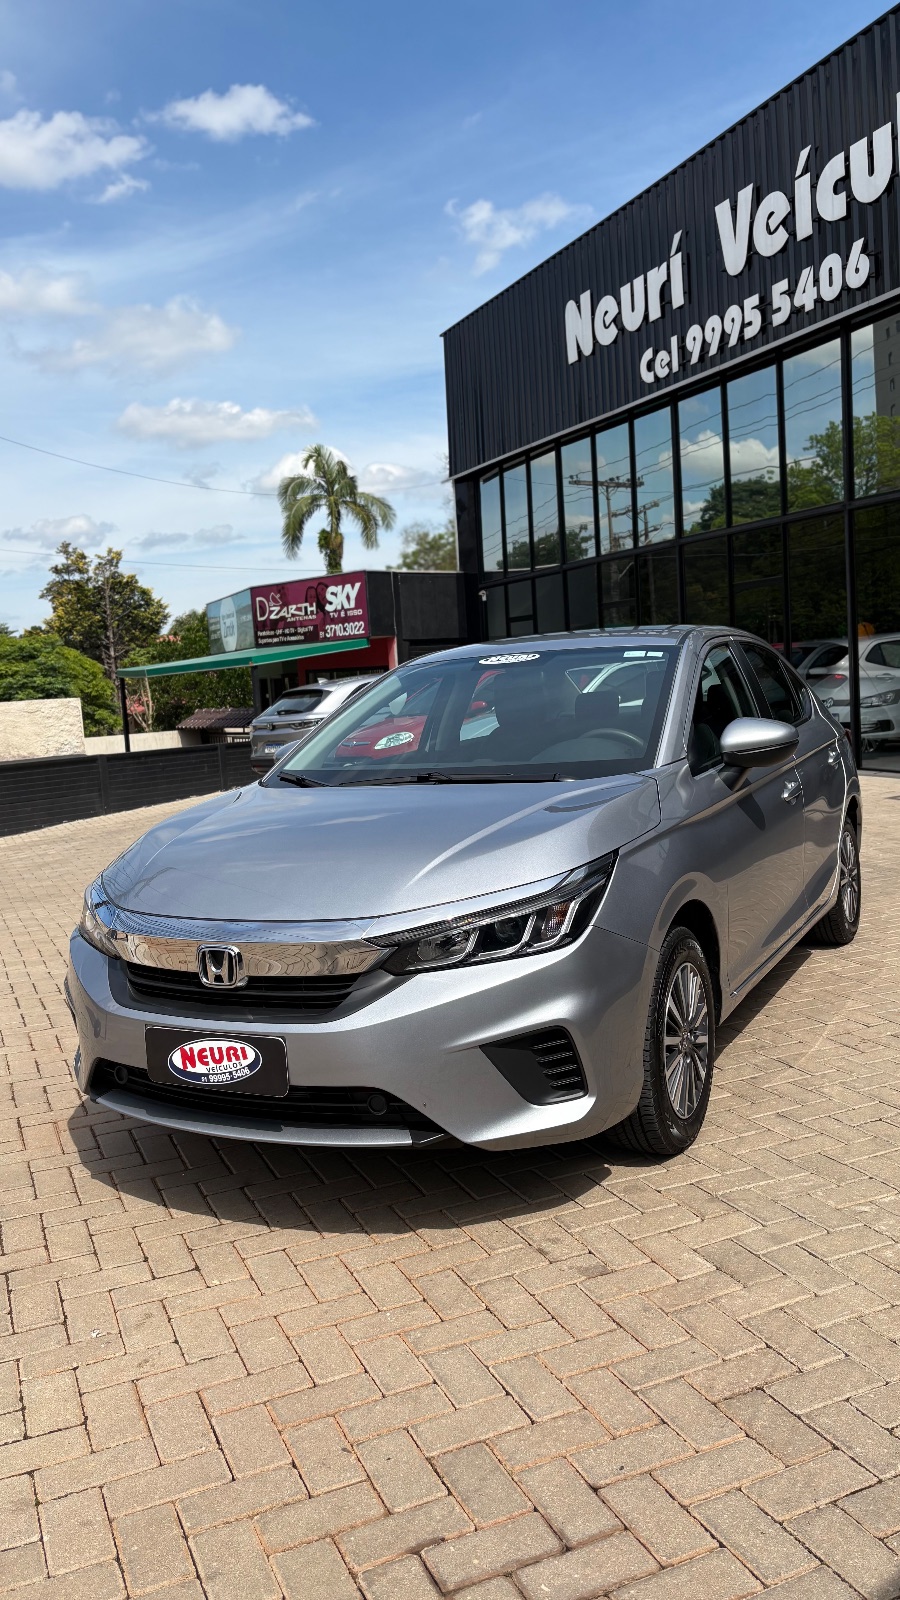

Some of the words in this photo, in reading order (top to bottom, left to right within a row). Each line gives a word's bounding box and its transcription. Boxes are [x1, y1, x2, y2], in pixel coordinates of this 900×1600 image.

[714, 91, 900, 276] Veícu
[640, 335, 679, 383] Cel
[685, 293, 762, 365] 9995
[771, 237, 870, 327] 5406
[325, 582, 361, 612] SKY
[325, 621, 365, 638] 3710.3022
[180, 1045, 249, 1071] NEURI
[208, 1066, 251, 1083] 99995-5406
